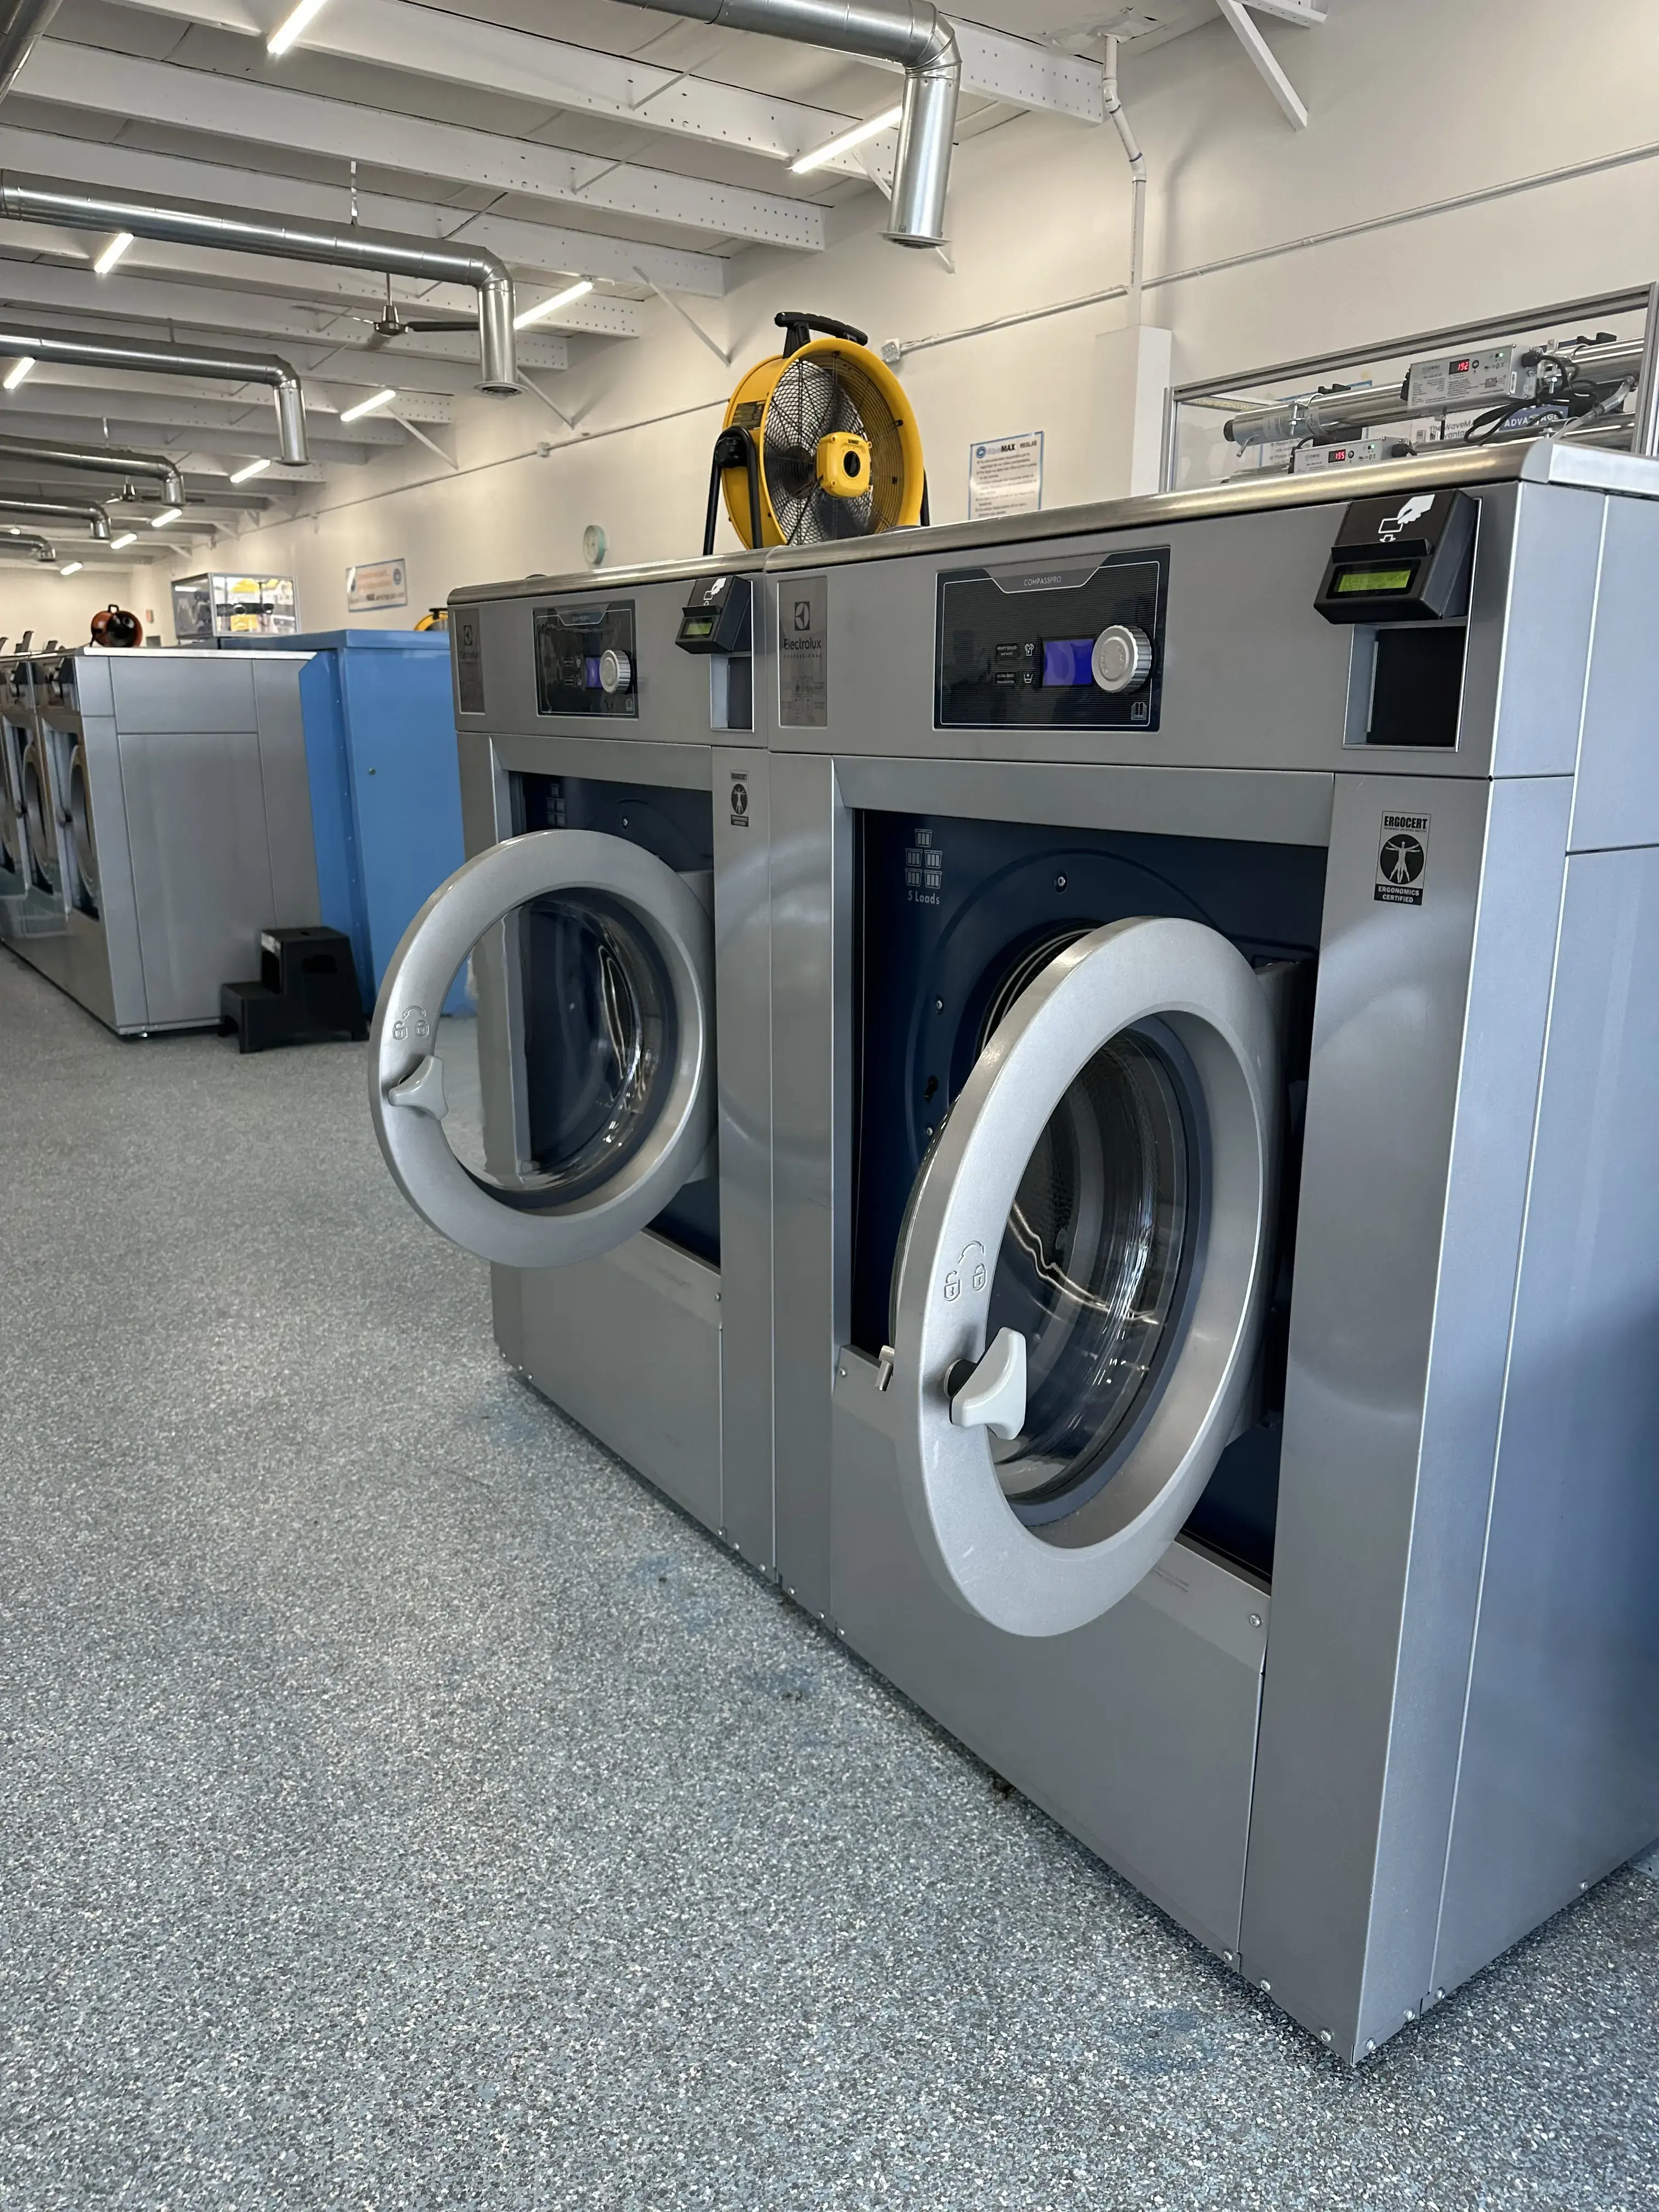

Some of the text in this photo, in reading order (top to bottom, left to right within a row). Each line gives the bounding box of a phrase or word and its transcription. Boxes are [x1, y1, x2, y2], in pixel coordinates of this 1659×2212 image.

[1504, 412, 1562, 428] ADVAAGE
[1024, 575, 1062, 586] COMPASSPRO
[783, 637, 821, 650] Electrolux
[1384, 816, 1427, 830] ERGOCERT
[1378, 885, 1420, 896] ERGONOMICS
[908, 890, 940, 905] 5 Loads
[1382, 894, 1414, 903] CERTIFIED
